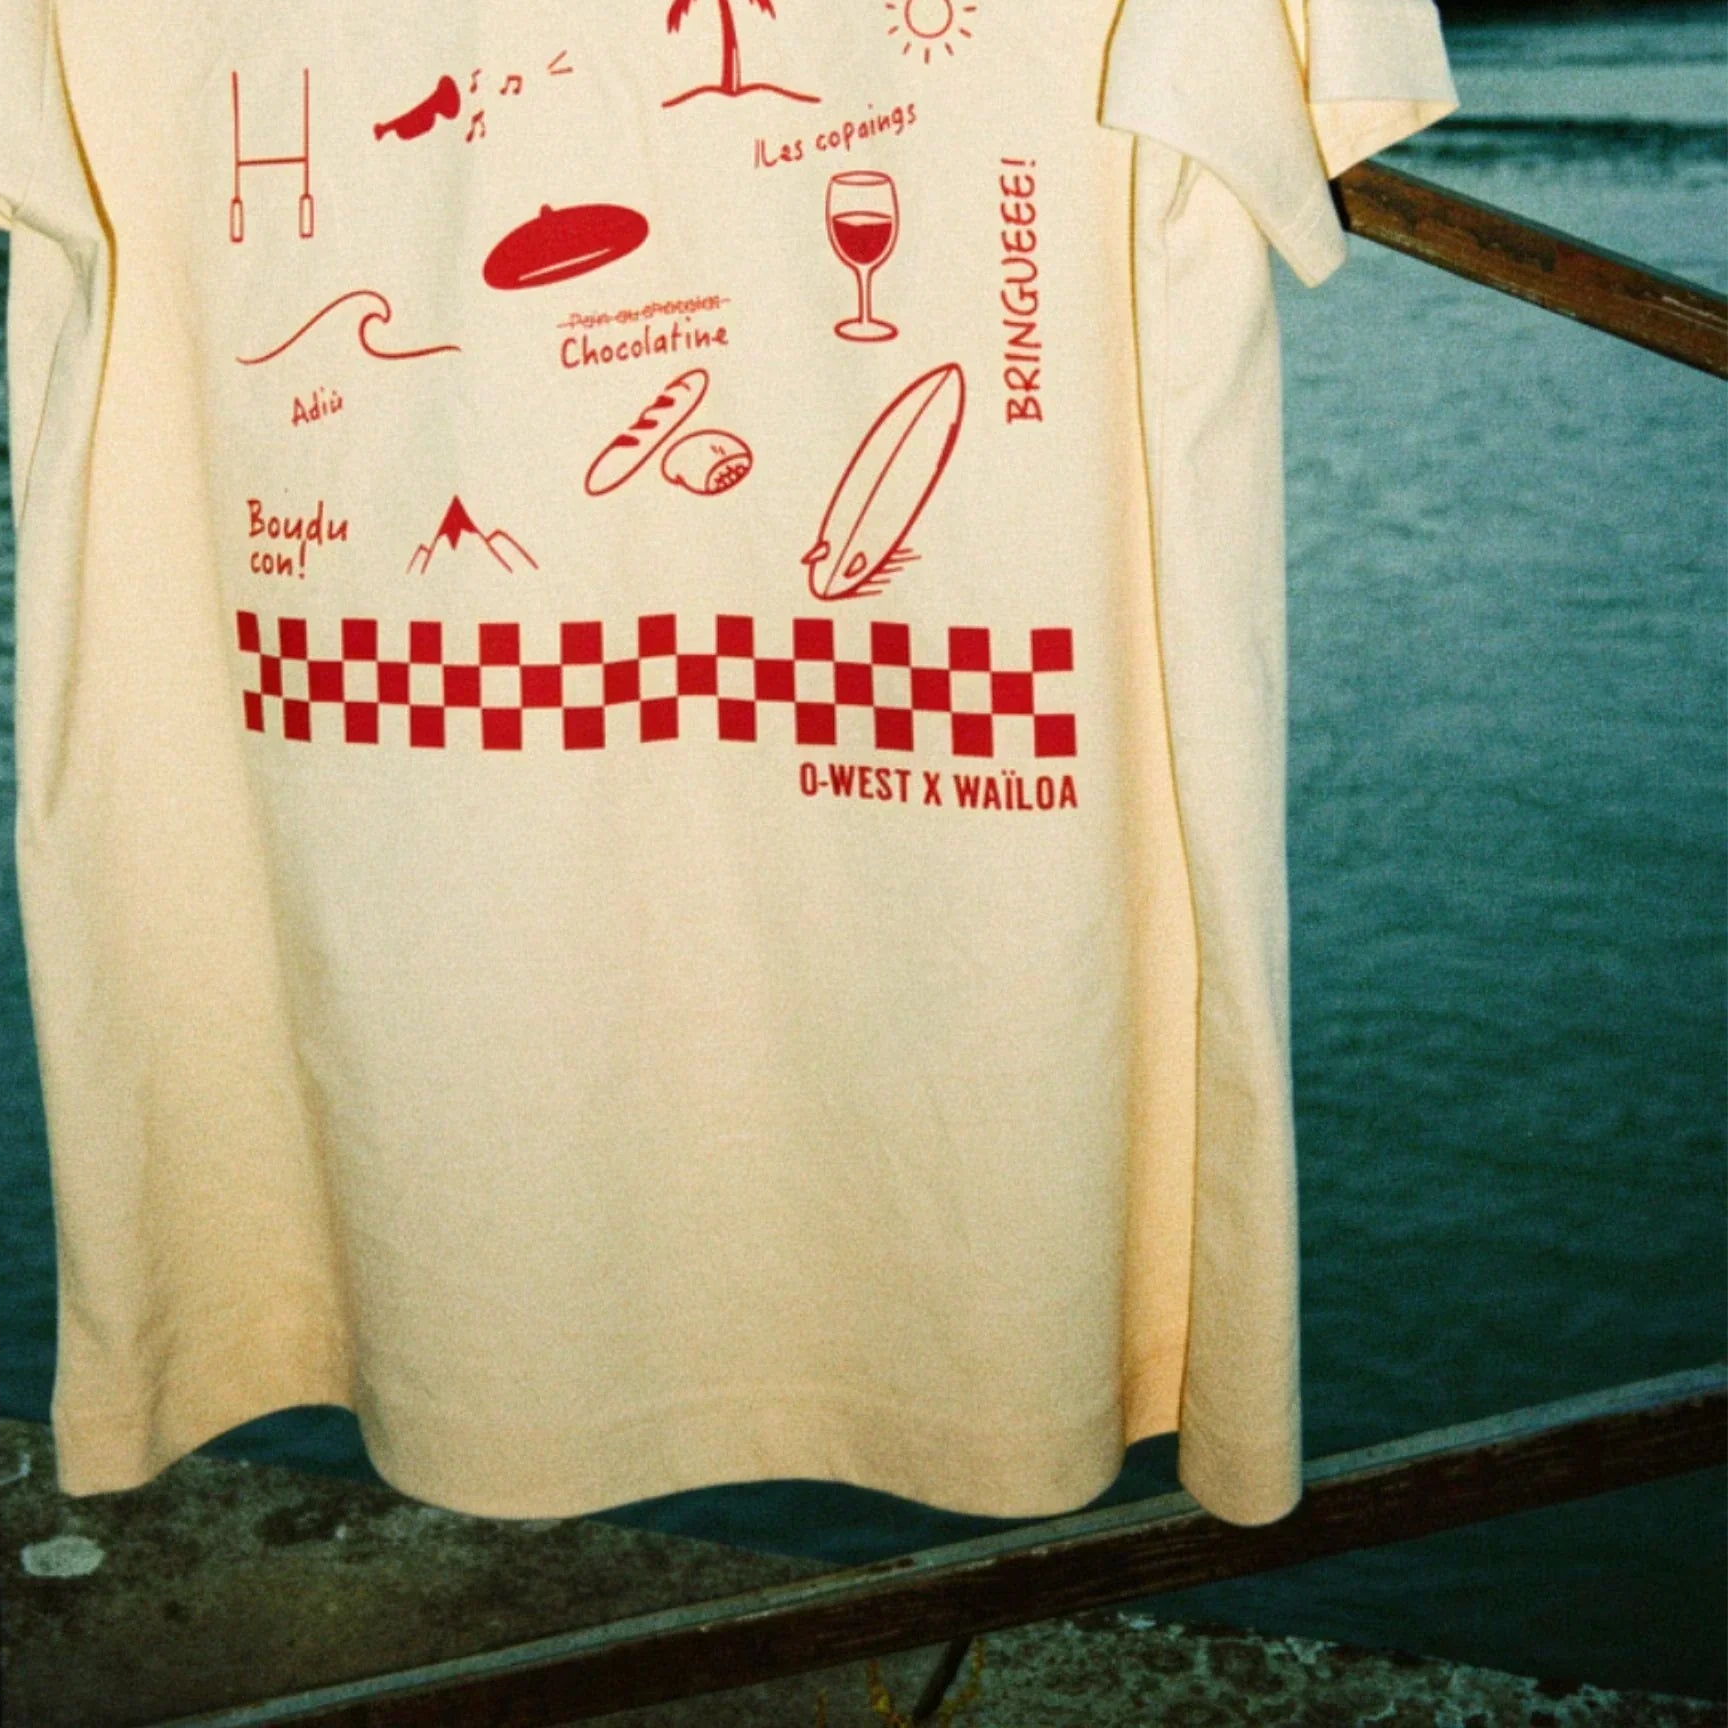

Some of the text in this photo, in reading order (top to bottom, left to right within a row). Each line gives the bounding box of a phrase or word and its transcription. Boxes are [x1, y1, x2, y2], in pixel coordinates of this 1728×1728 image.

[815, 103, 918, 152] copaings
[999, 156, 1043, 424] BRINGUEEE!
[560, 315, 730, 369] Chocolatine
[246, 498, 349, 546] Boudu
[798, 762, 1079, 811] O-WEST X WAÏLOA
